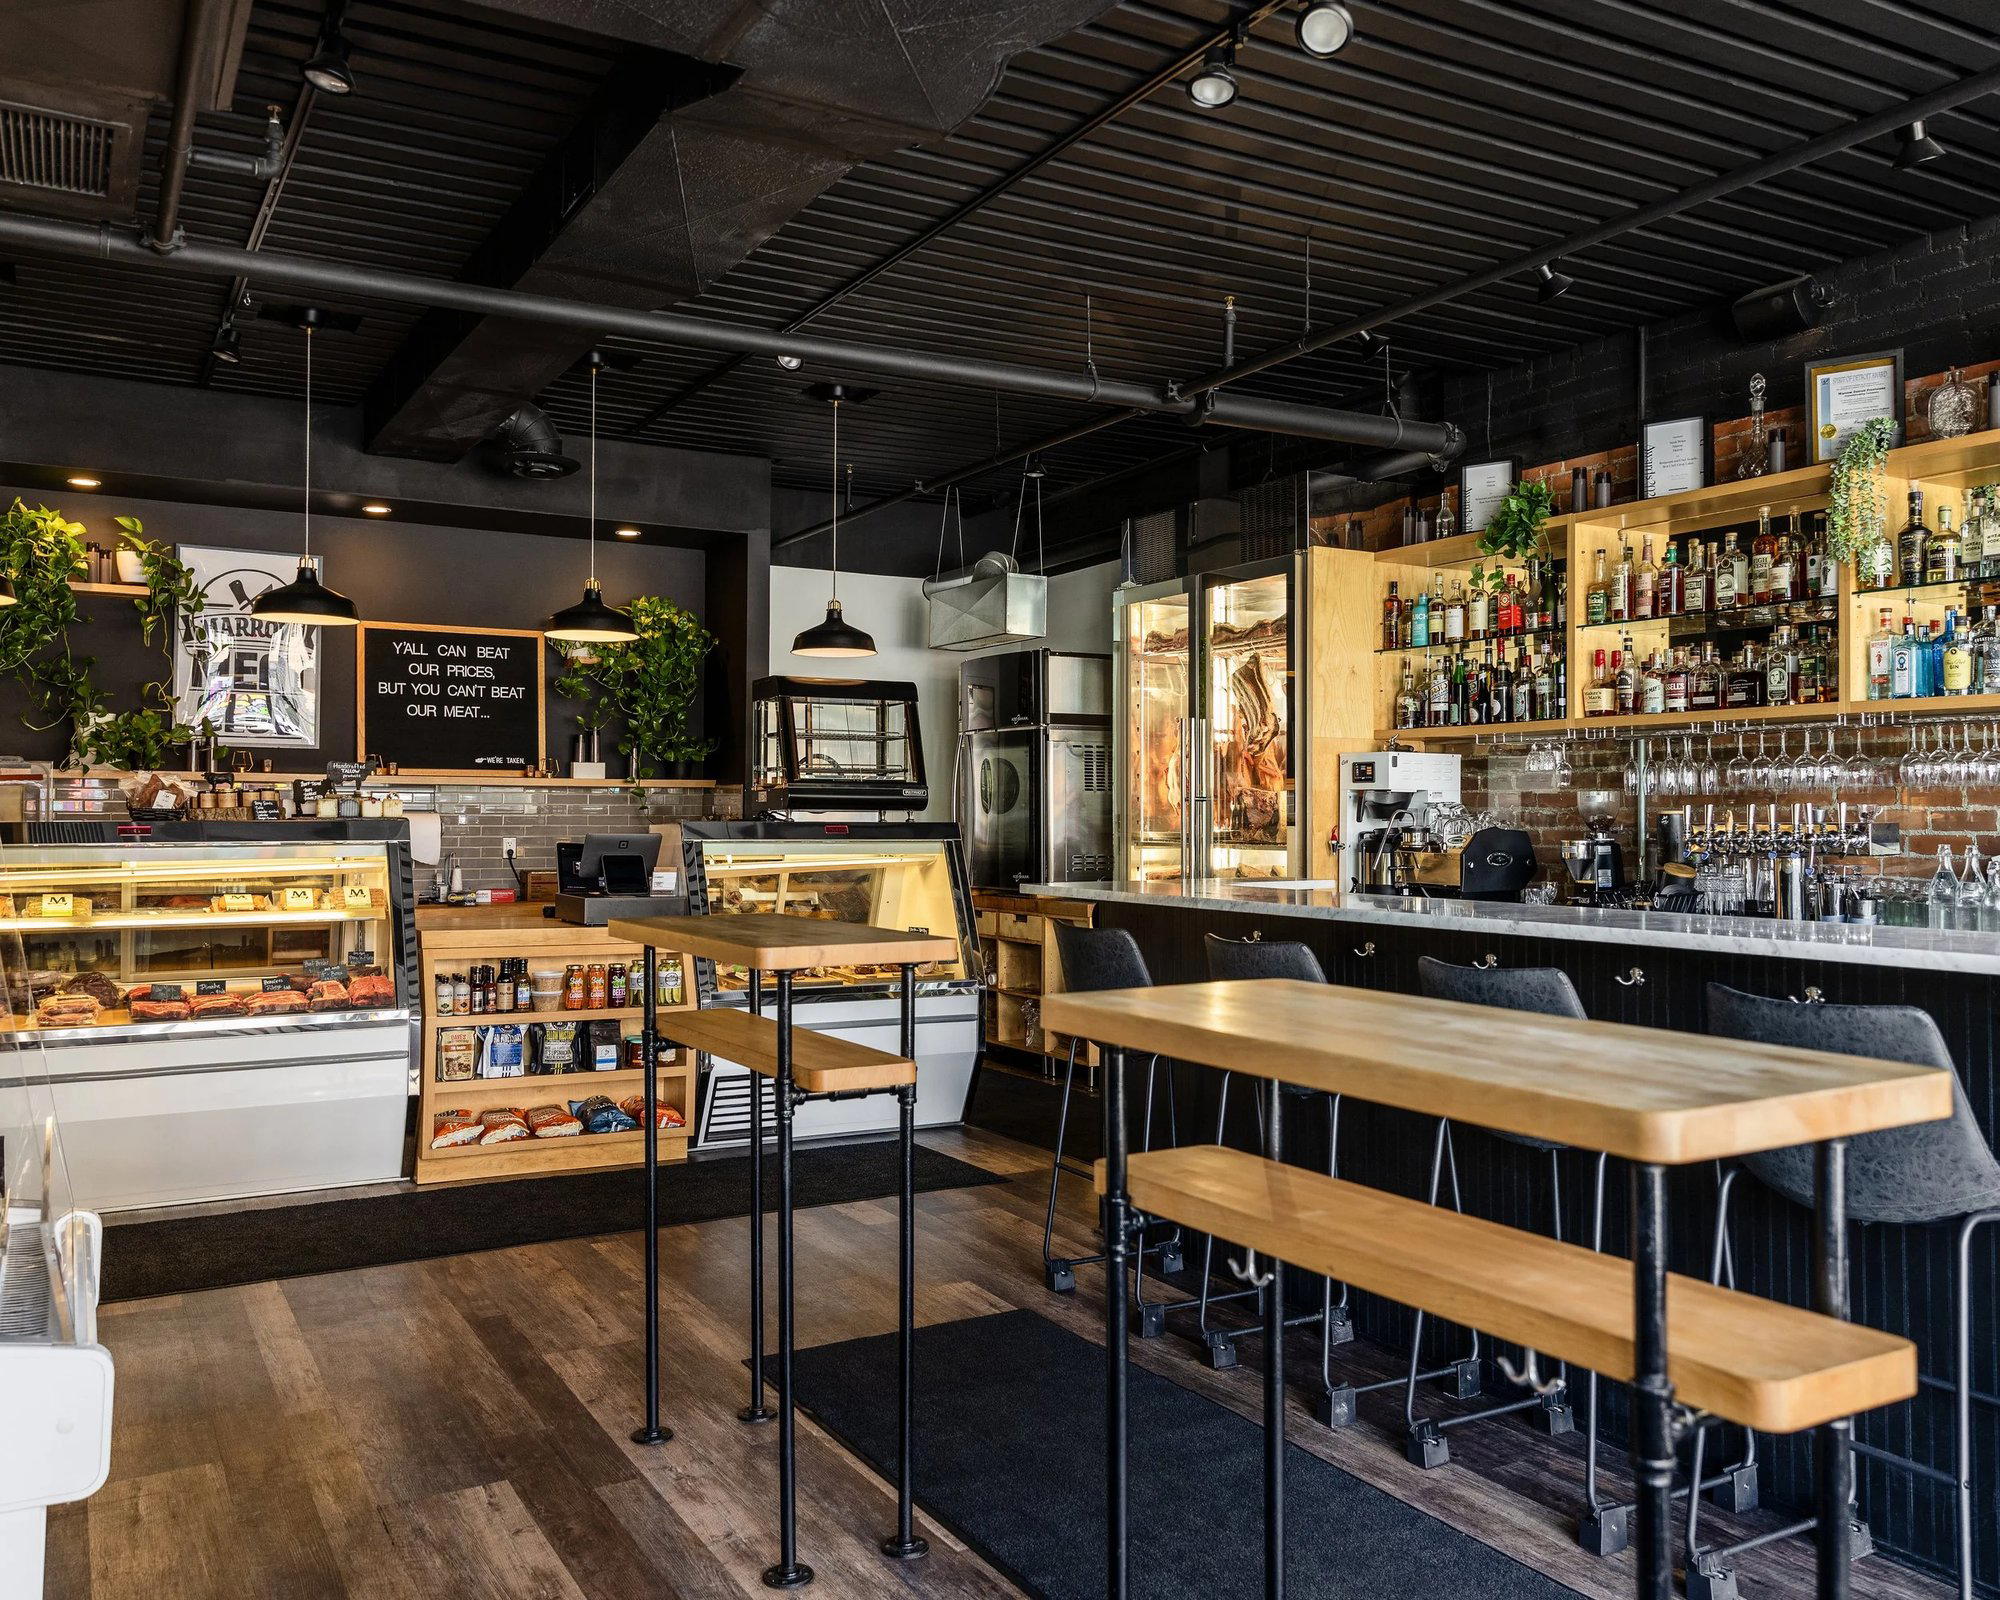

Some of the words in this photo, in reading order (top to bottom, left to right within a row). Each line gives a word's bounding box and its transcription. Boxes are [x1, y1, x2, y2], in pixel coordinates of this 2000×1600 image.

[392, 641, 428, 656] Y'ALL
[437, 644, 467, 658] CAN
[476, 646, 511, 660] BEAT
[408, 662, 440, 676] OUR
[446, 664, 496, 680] PRICES,
[378, 681, 407, 695] BUT
[411, 682, 441, 696] YOU
[447, 684, 486, 698] CAN'T
[491, 686, 526, 699] BEAT
[406, 703, 437, 717] OUR
[443, 705, 491, 719] MEAT...
